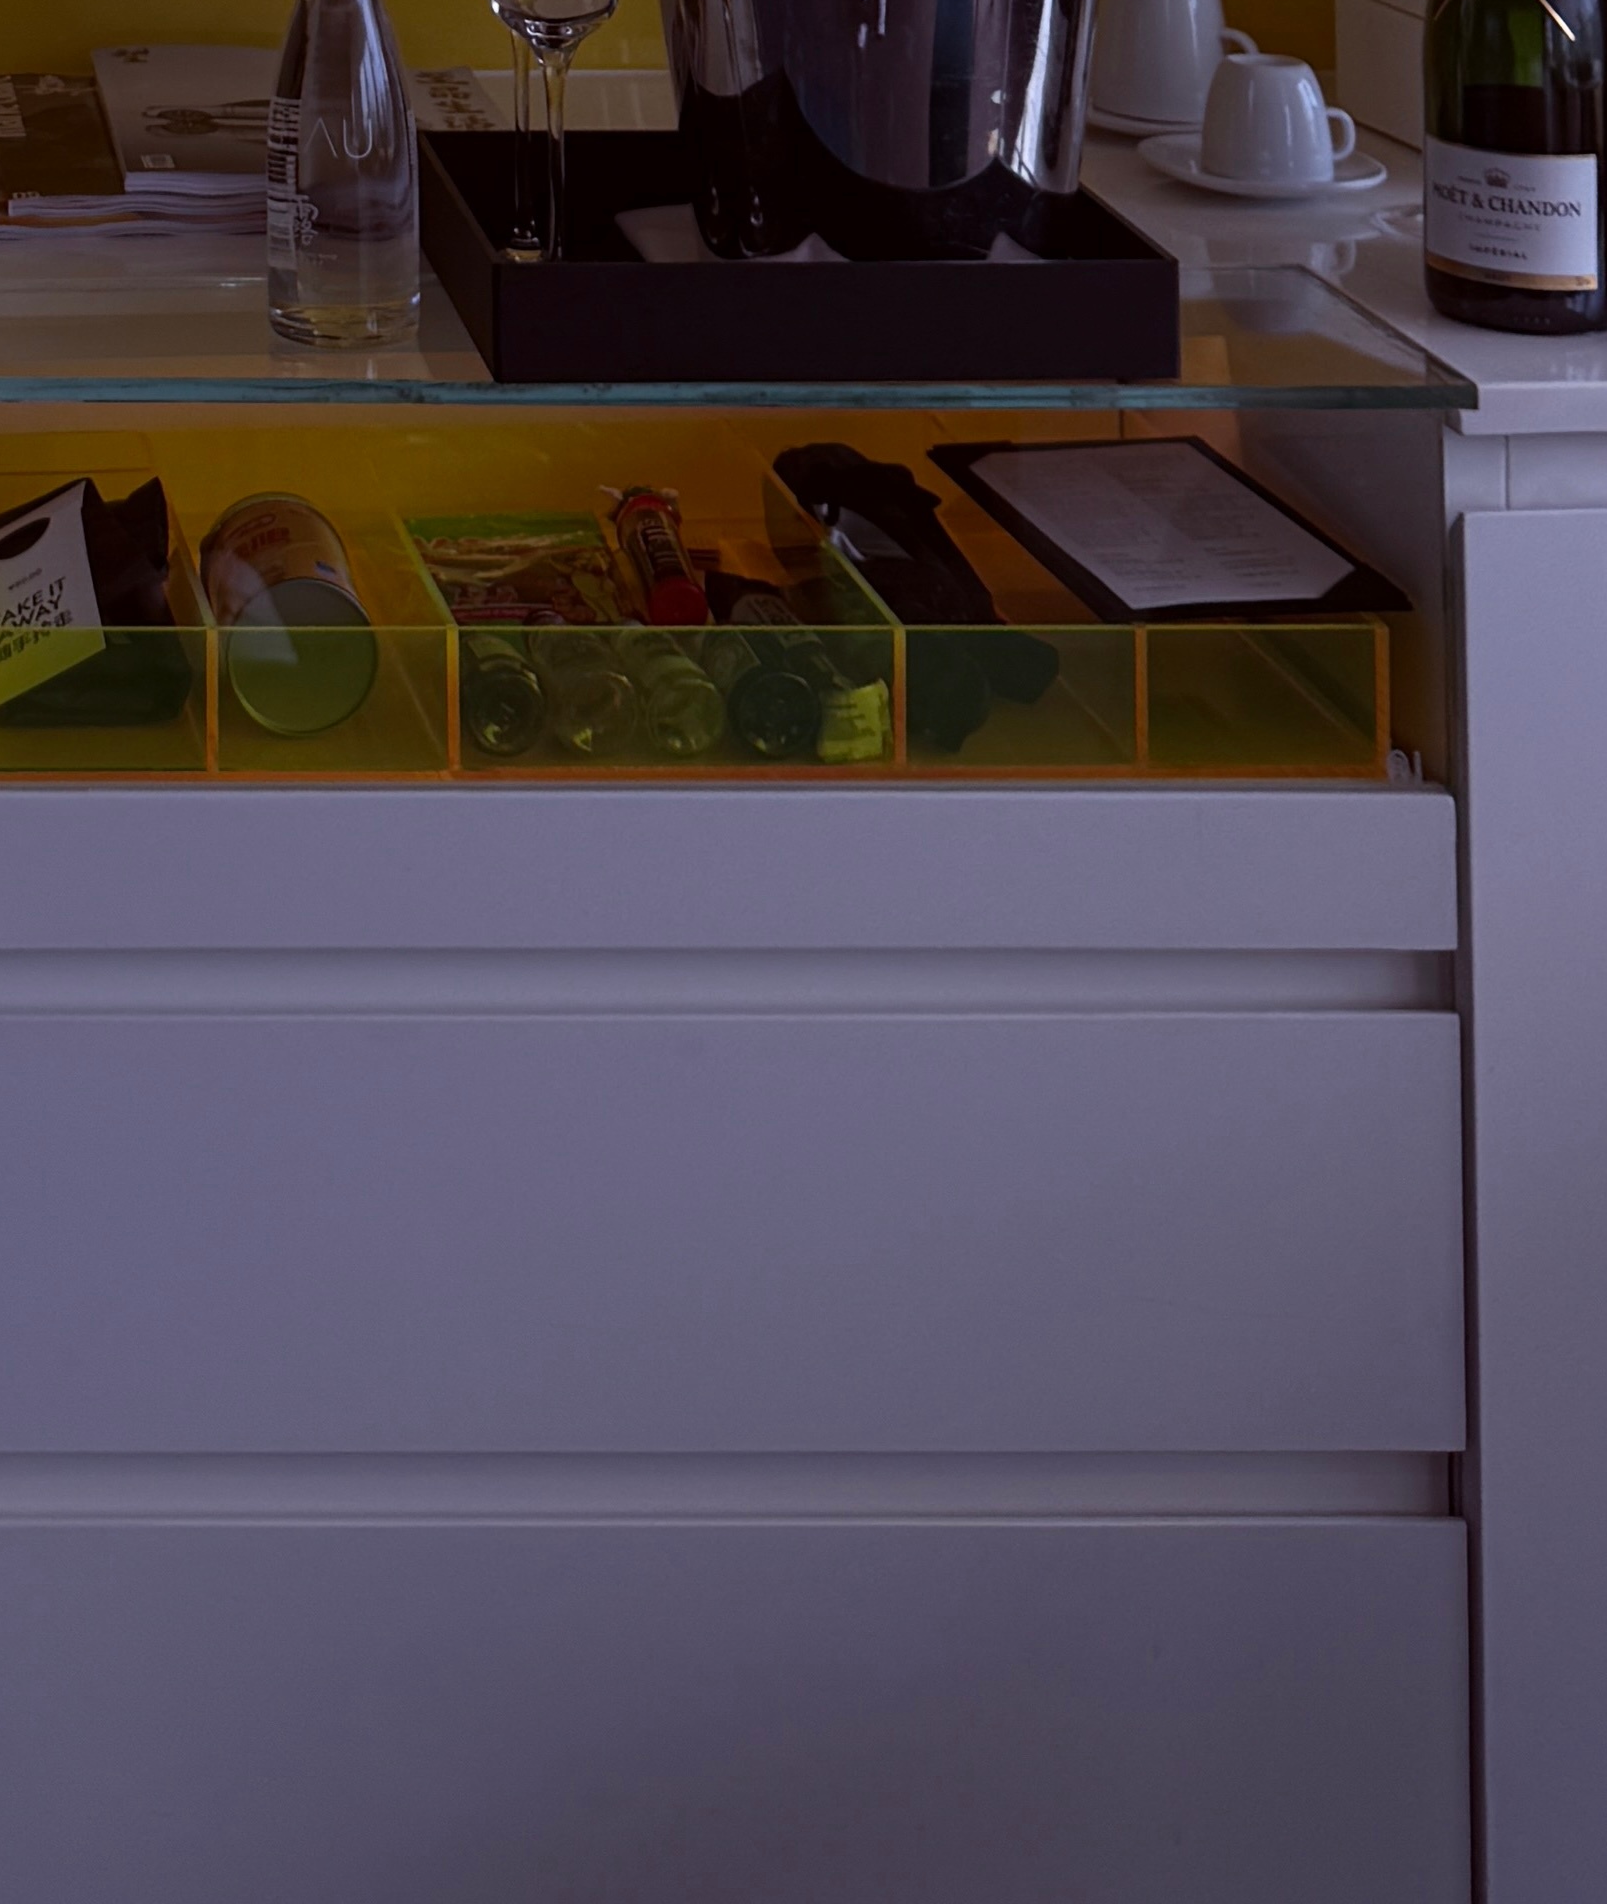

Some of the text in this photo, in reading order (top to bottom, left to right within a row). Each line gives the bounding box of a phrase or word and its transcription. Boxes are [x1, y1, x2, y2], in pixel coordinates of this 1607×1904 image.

[1472, 193, 1484, 209] &
[1488, 194, 1582, 217] CHANDON
[49, 575, 66, 596] IT
